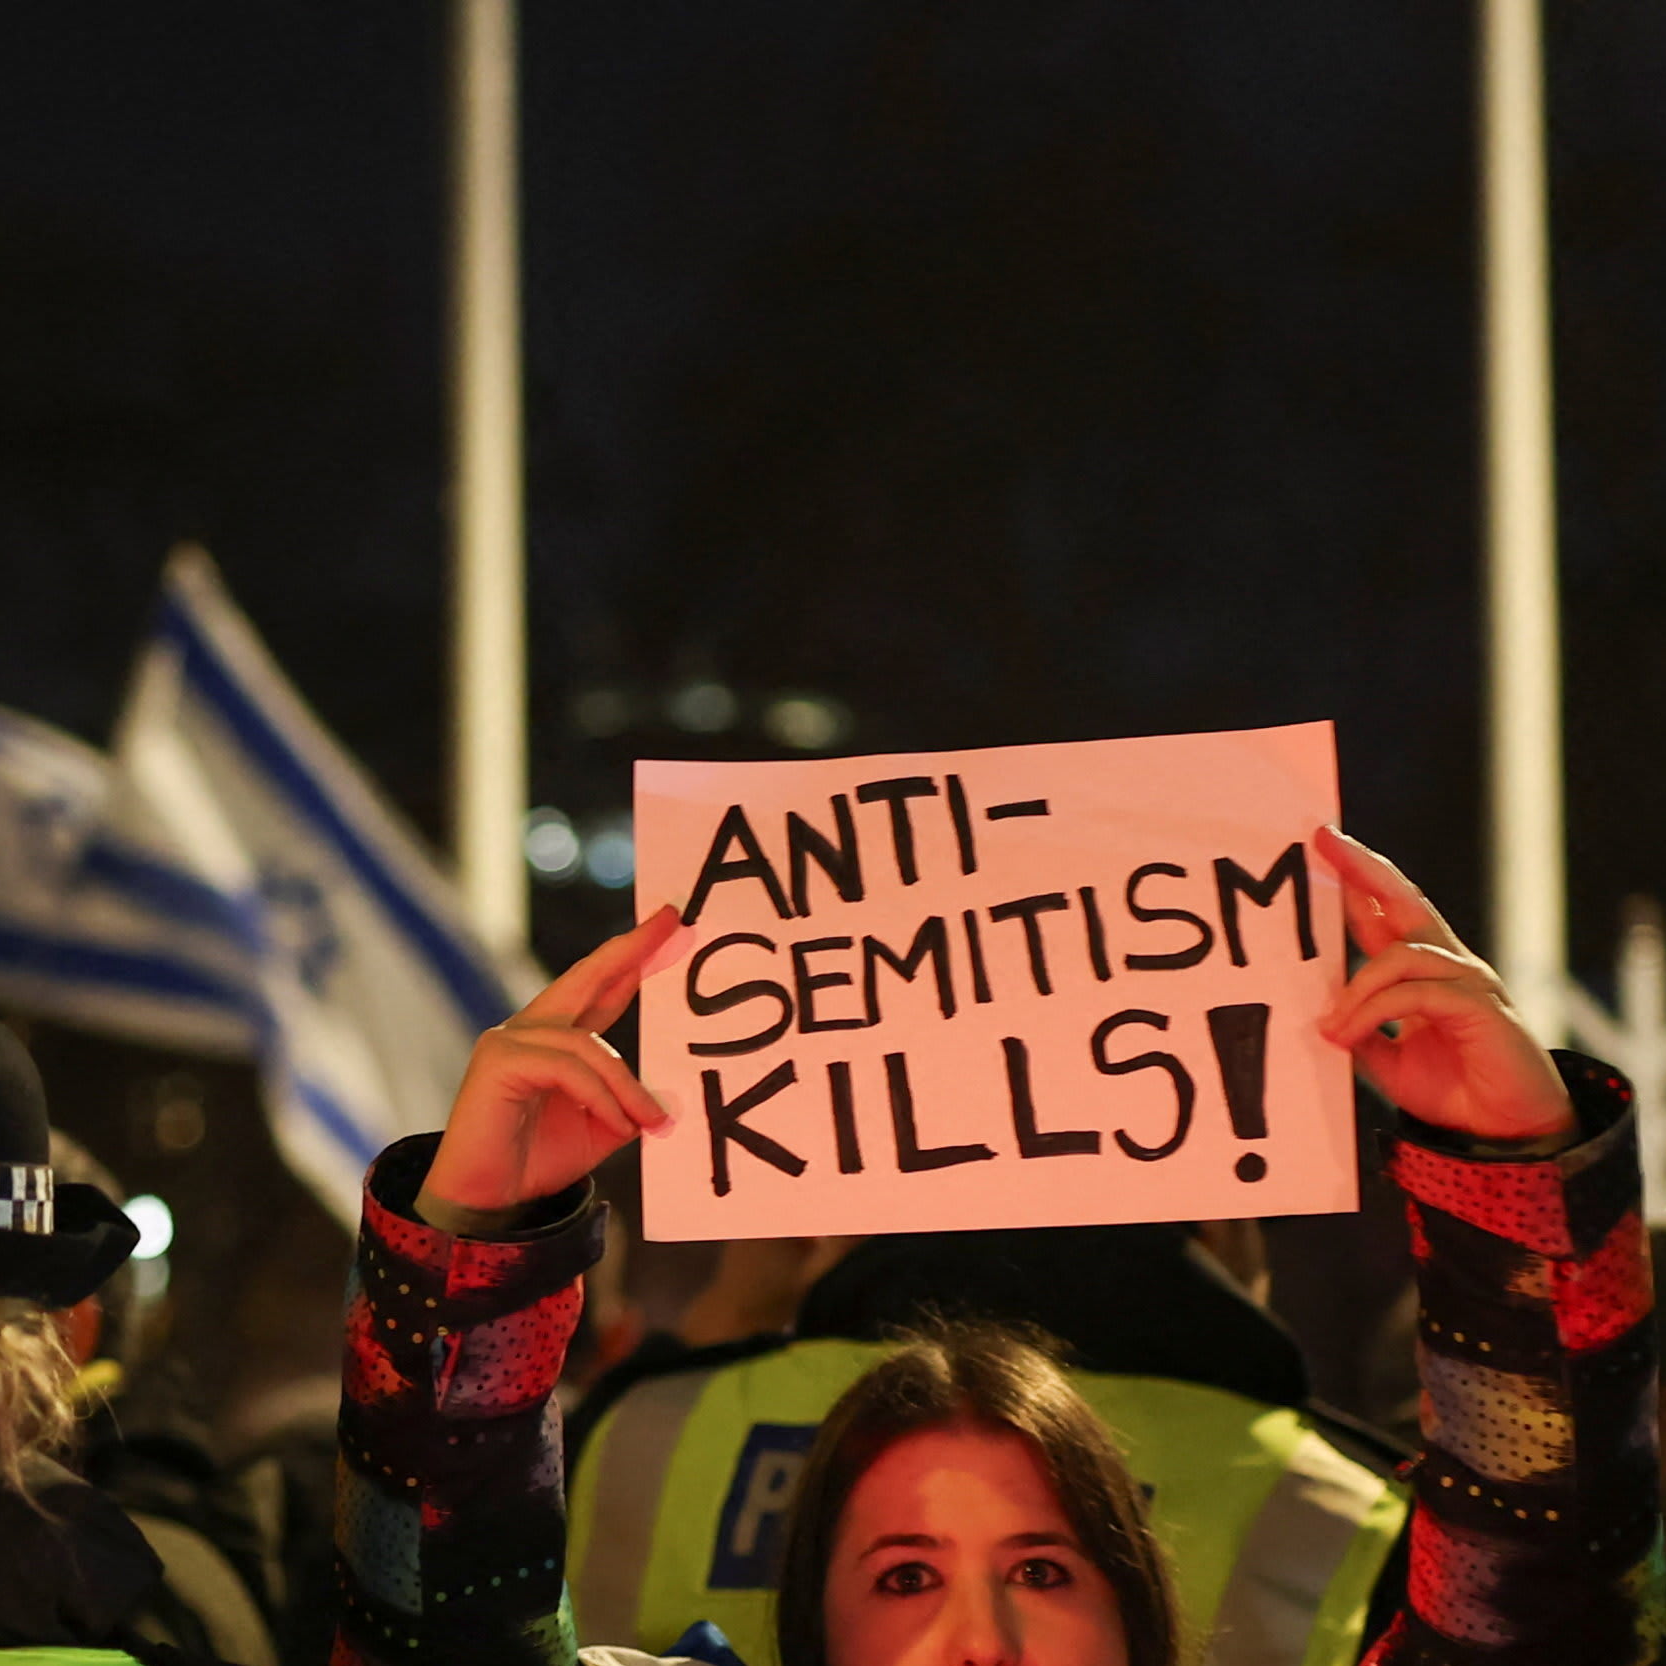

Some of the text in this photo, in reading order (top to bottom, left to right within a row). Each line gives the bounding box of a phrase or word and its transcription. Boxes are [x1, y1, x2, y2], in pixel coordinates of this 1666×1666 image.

[679, 773, 1050, 927] ANTI-
[686, 842, 1319, 1057] SEMITISM
[700, 1002, 1270, 1198] KILLS!
